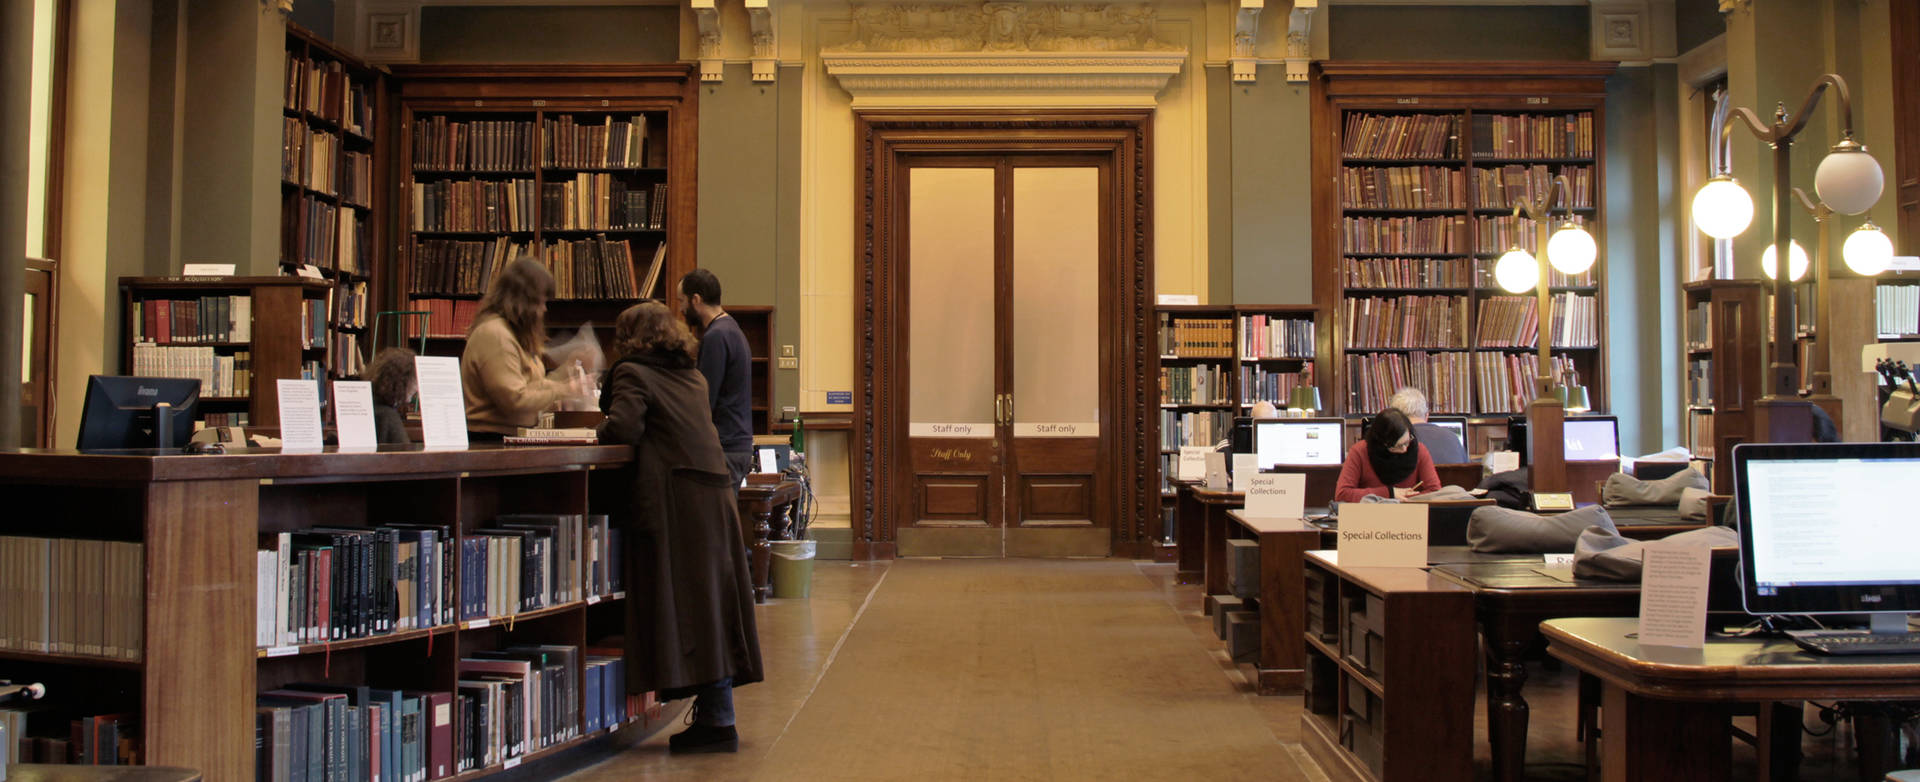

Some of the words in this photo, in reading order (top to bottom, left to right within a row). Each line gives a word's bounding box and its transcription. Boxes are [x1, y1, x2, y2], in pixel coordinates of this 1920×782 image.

[932, 424, 952, 433] Staff
[954, 425, 972, 435] only
[1036, 424, 1057, 433] Staff
[1058, 424, 1076, 434] only
[930, 447, 953, 461] Staff
[953, 447, 972, 461] Only
[1251, 477, 1274, 486] Special
[1250, 487, 1286, 495] Collections
[1342, 530, 1373, 542] Special
[1374, 530, 1423, 541] Collections
